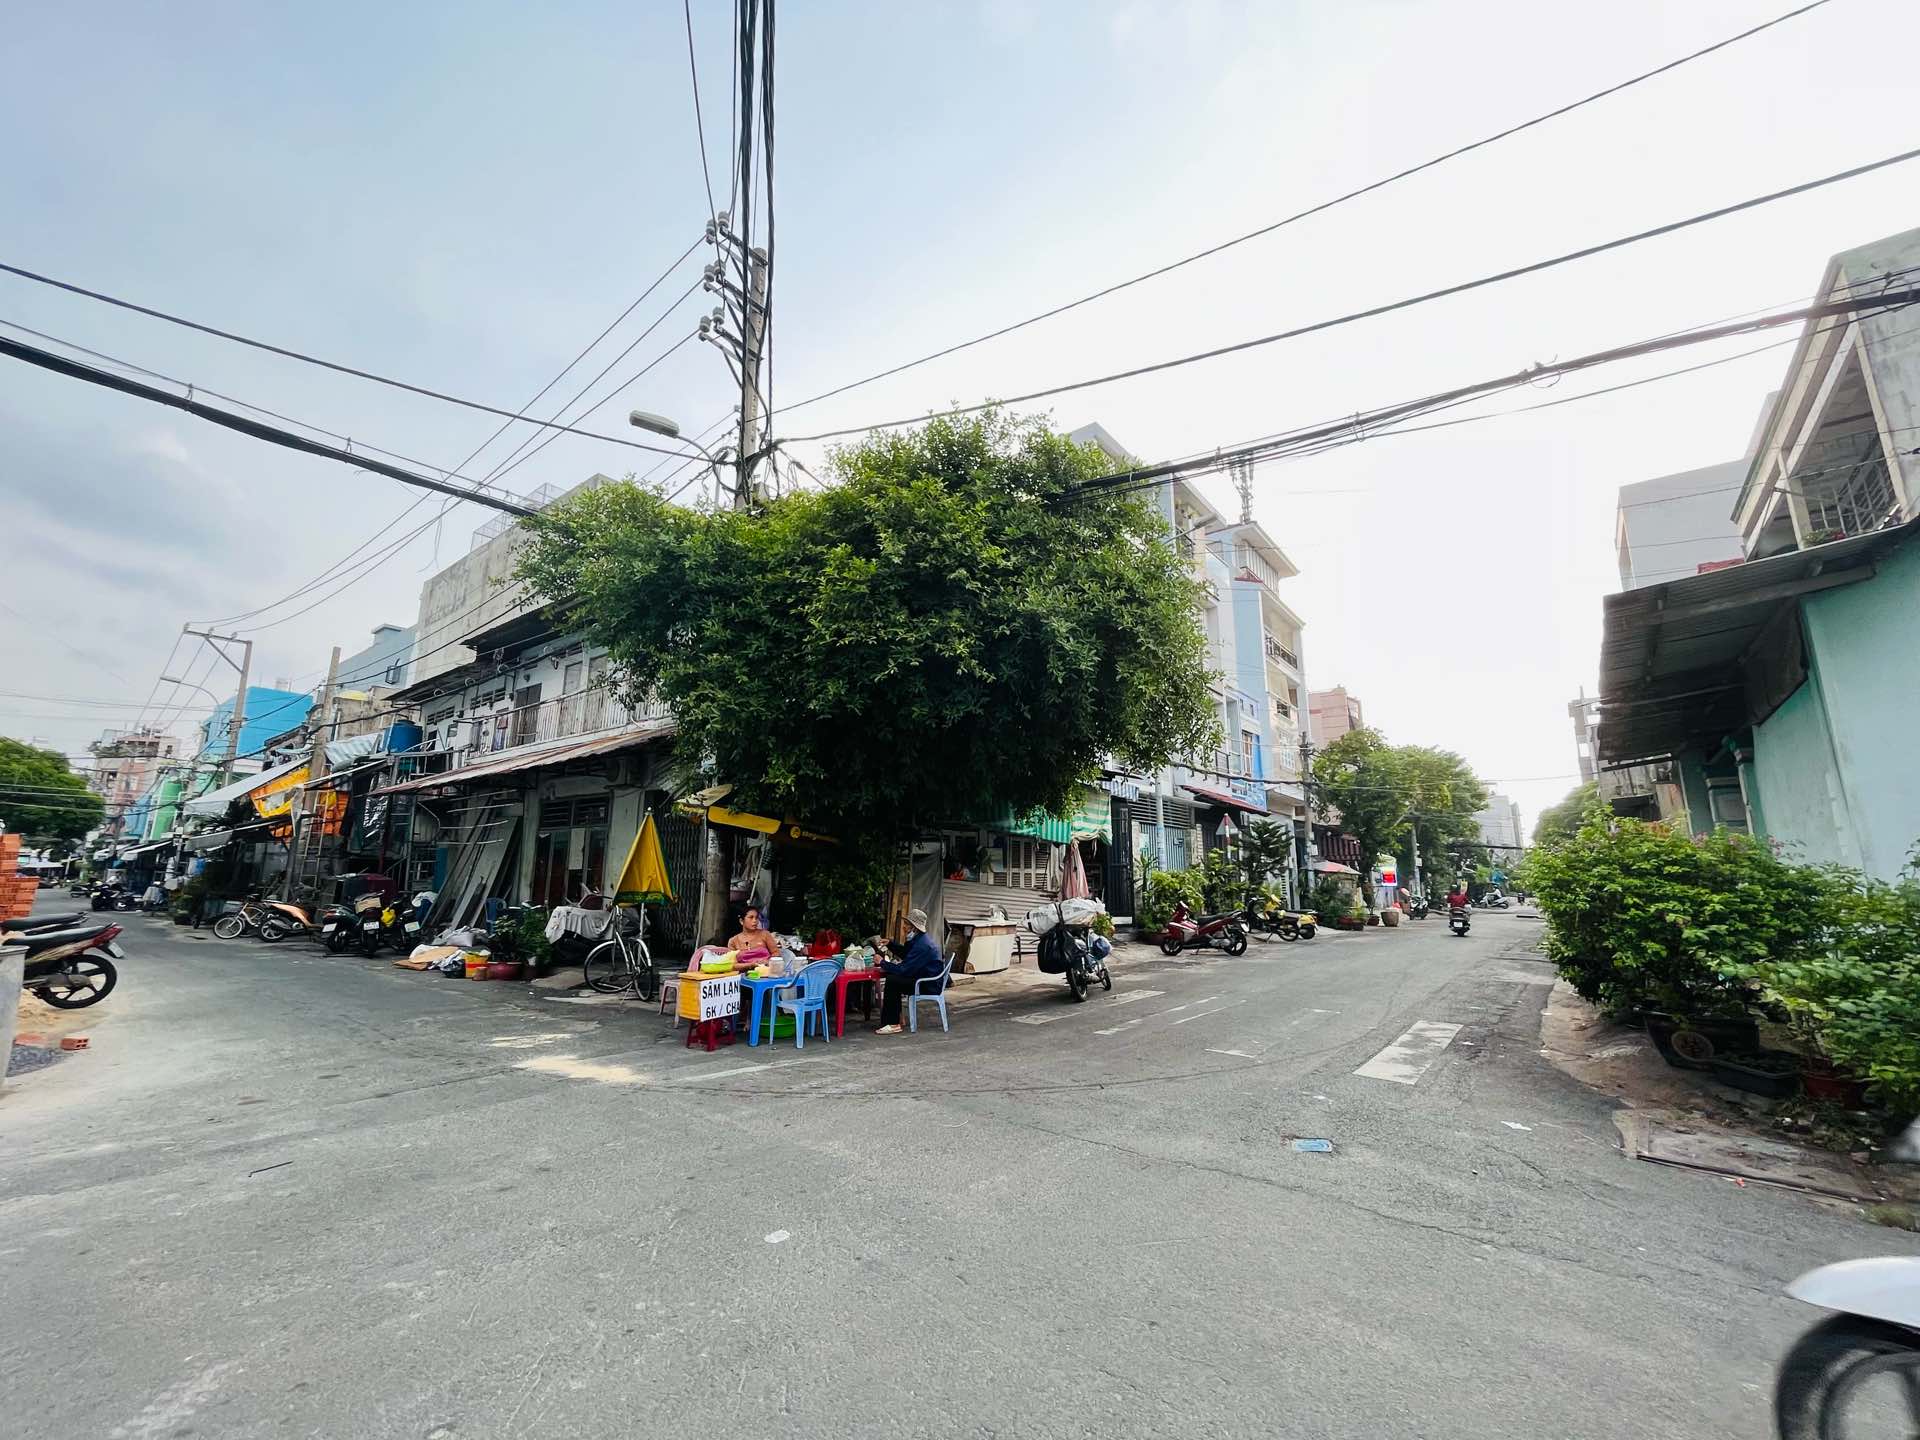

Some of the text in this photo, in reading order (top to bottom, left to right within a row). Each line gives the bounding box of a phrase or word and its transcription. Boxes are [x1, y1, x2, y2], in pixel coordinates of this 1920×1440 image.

[703, 981, 720, 999] SÂM
[706, 1006, 717, 1018] 6K
[719, 1004, 723, 1016] /
